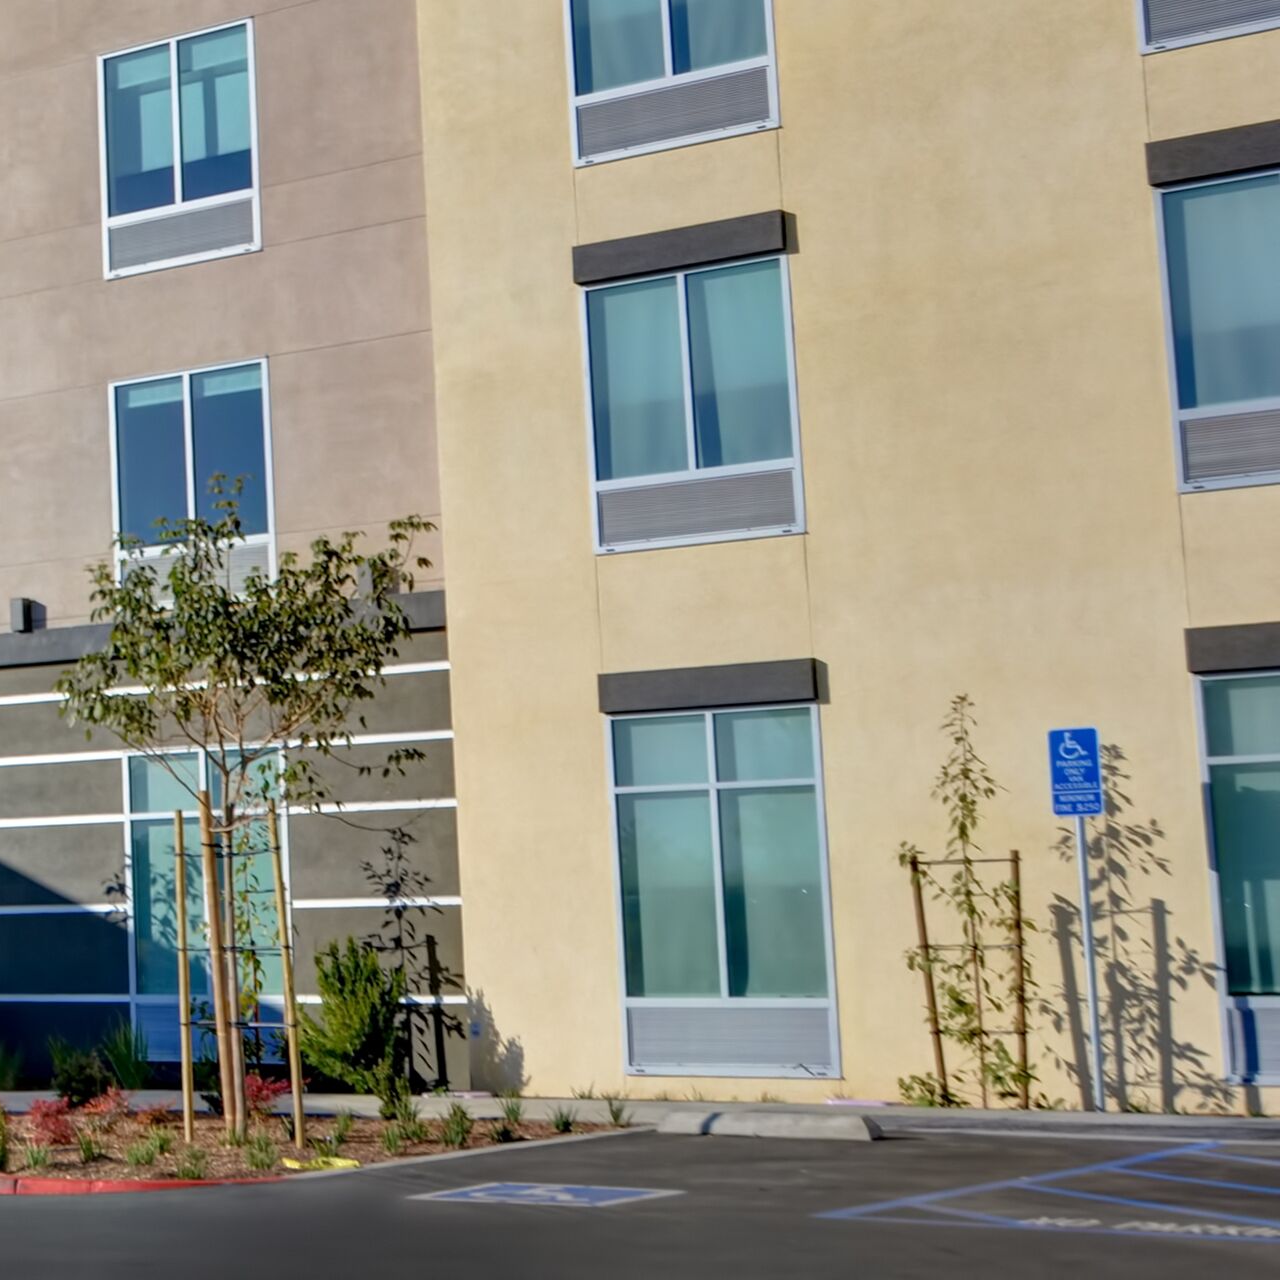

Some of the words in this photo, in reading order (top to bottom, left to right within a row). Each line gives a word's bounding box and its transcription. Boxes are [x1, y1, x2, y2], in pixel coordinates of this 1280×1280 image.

[1055, 759, 1093, 768] PARKING
[1063, 767, 1086, 776] ONLY
[1054, 781, 1098, 790] ACCESSIBLE
